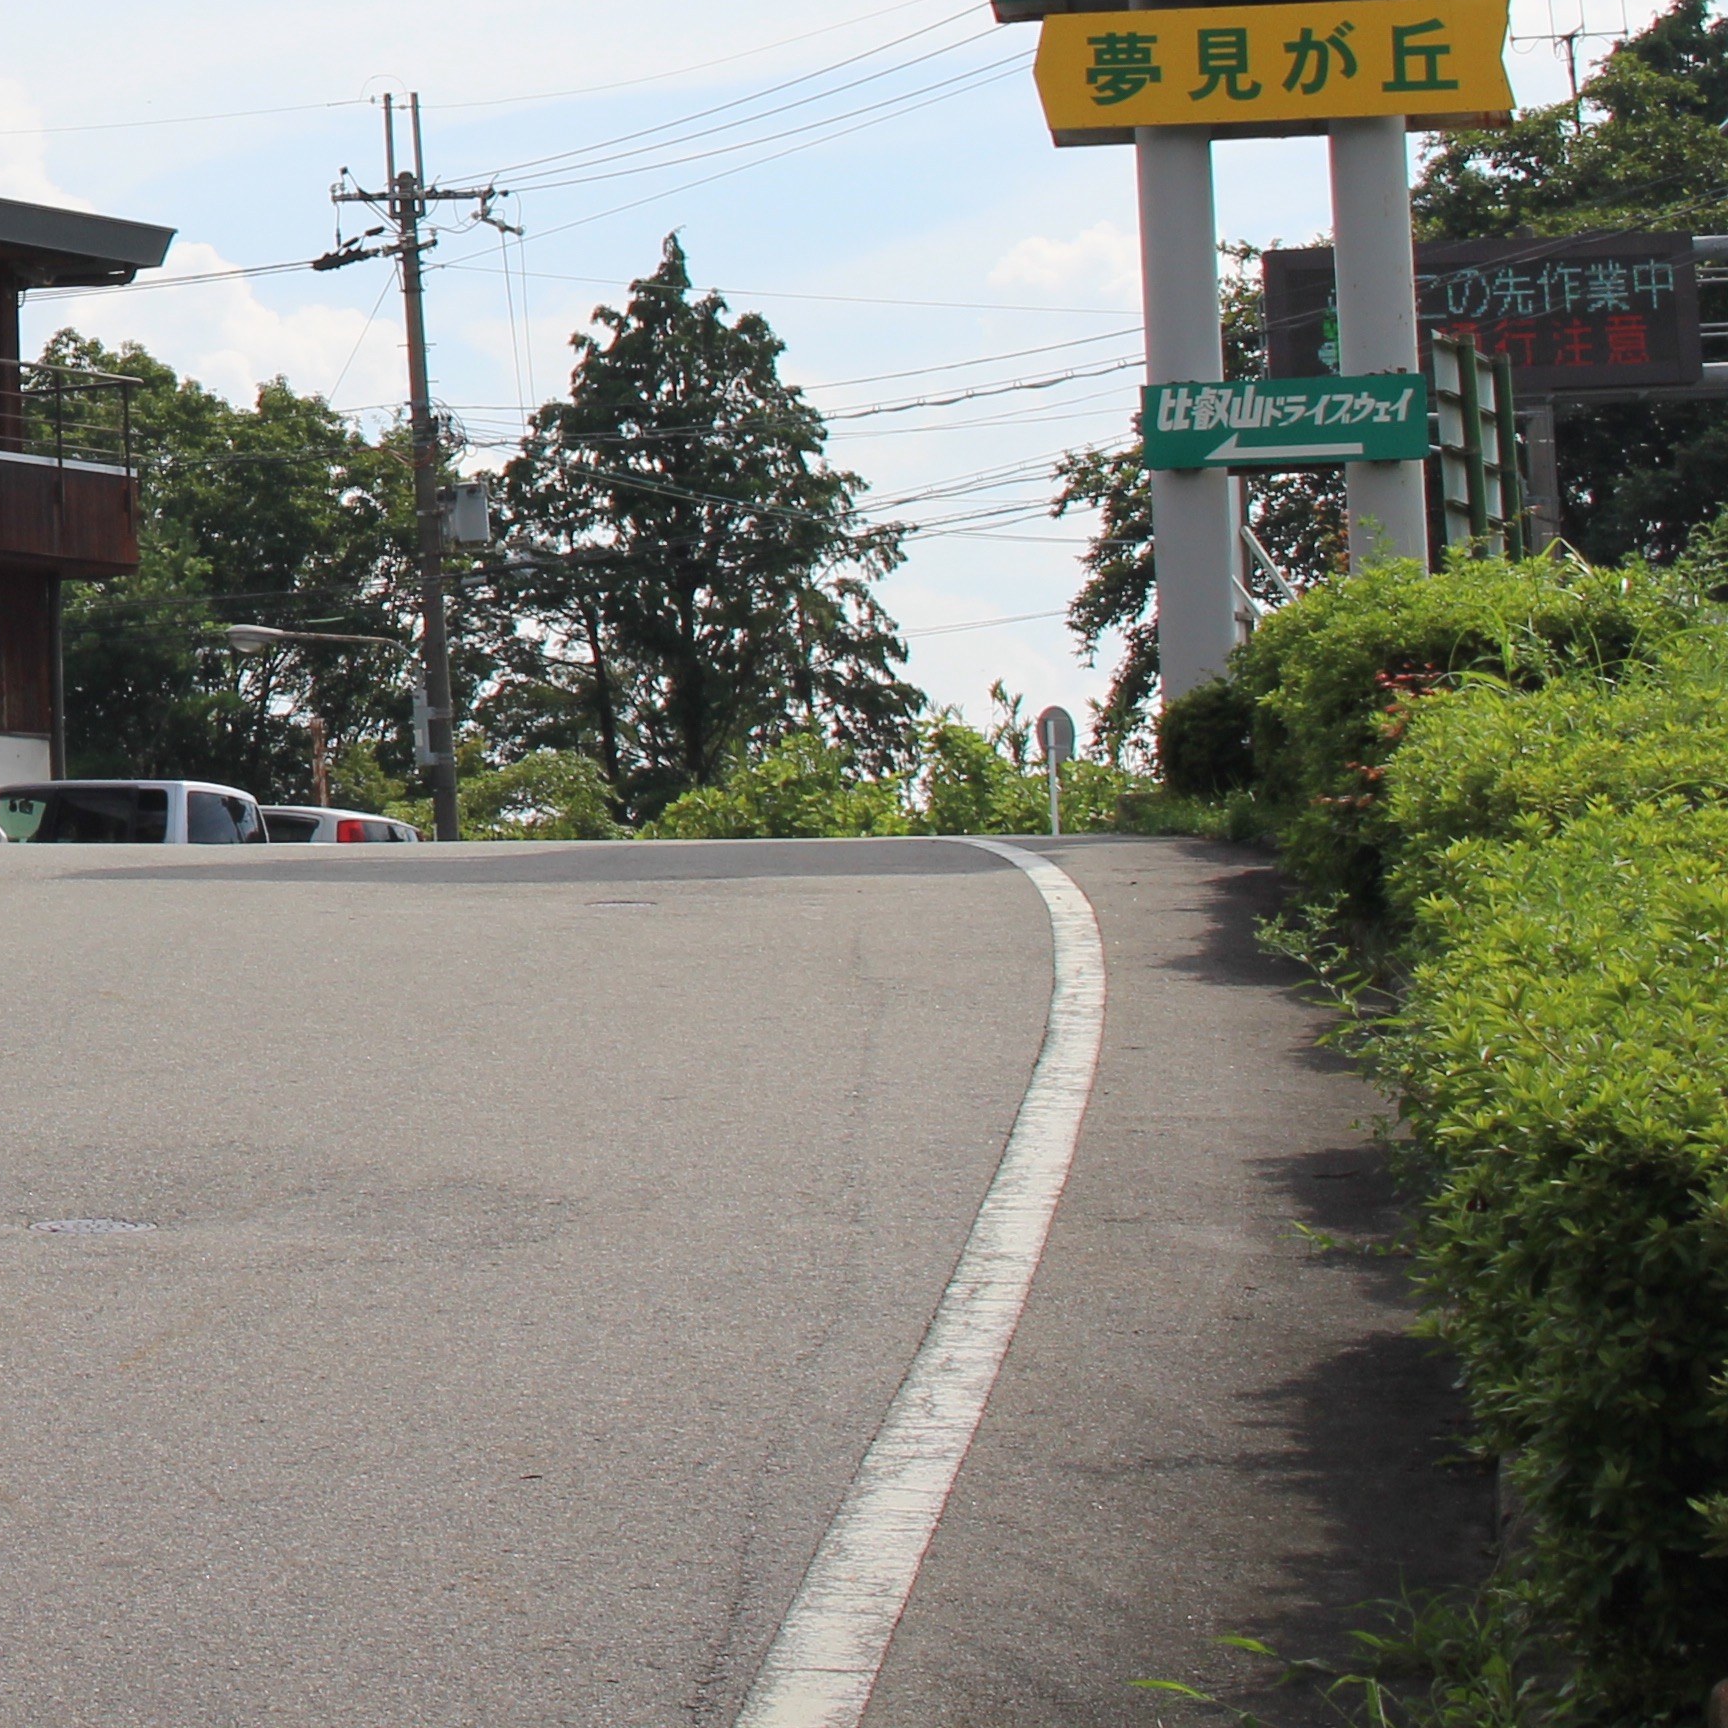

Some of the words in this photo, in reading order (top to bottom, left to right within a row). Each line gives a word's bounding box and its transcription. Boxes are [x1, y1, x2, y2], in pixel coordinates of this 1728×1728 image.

[1085, 18, 1459, 107] 夢見が丘
[1417, 258, 1675, 319] この先作業中
[1155, 384, 1415, 434] 比叡山ドライブウェイ
